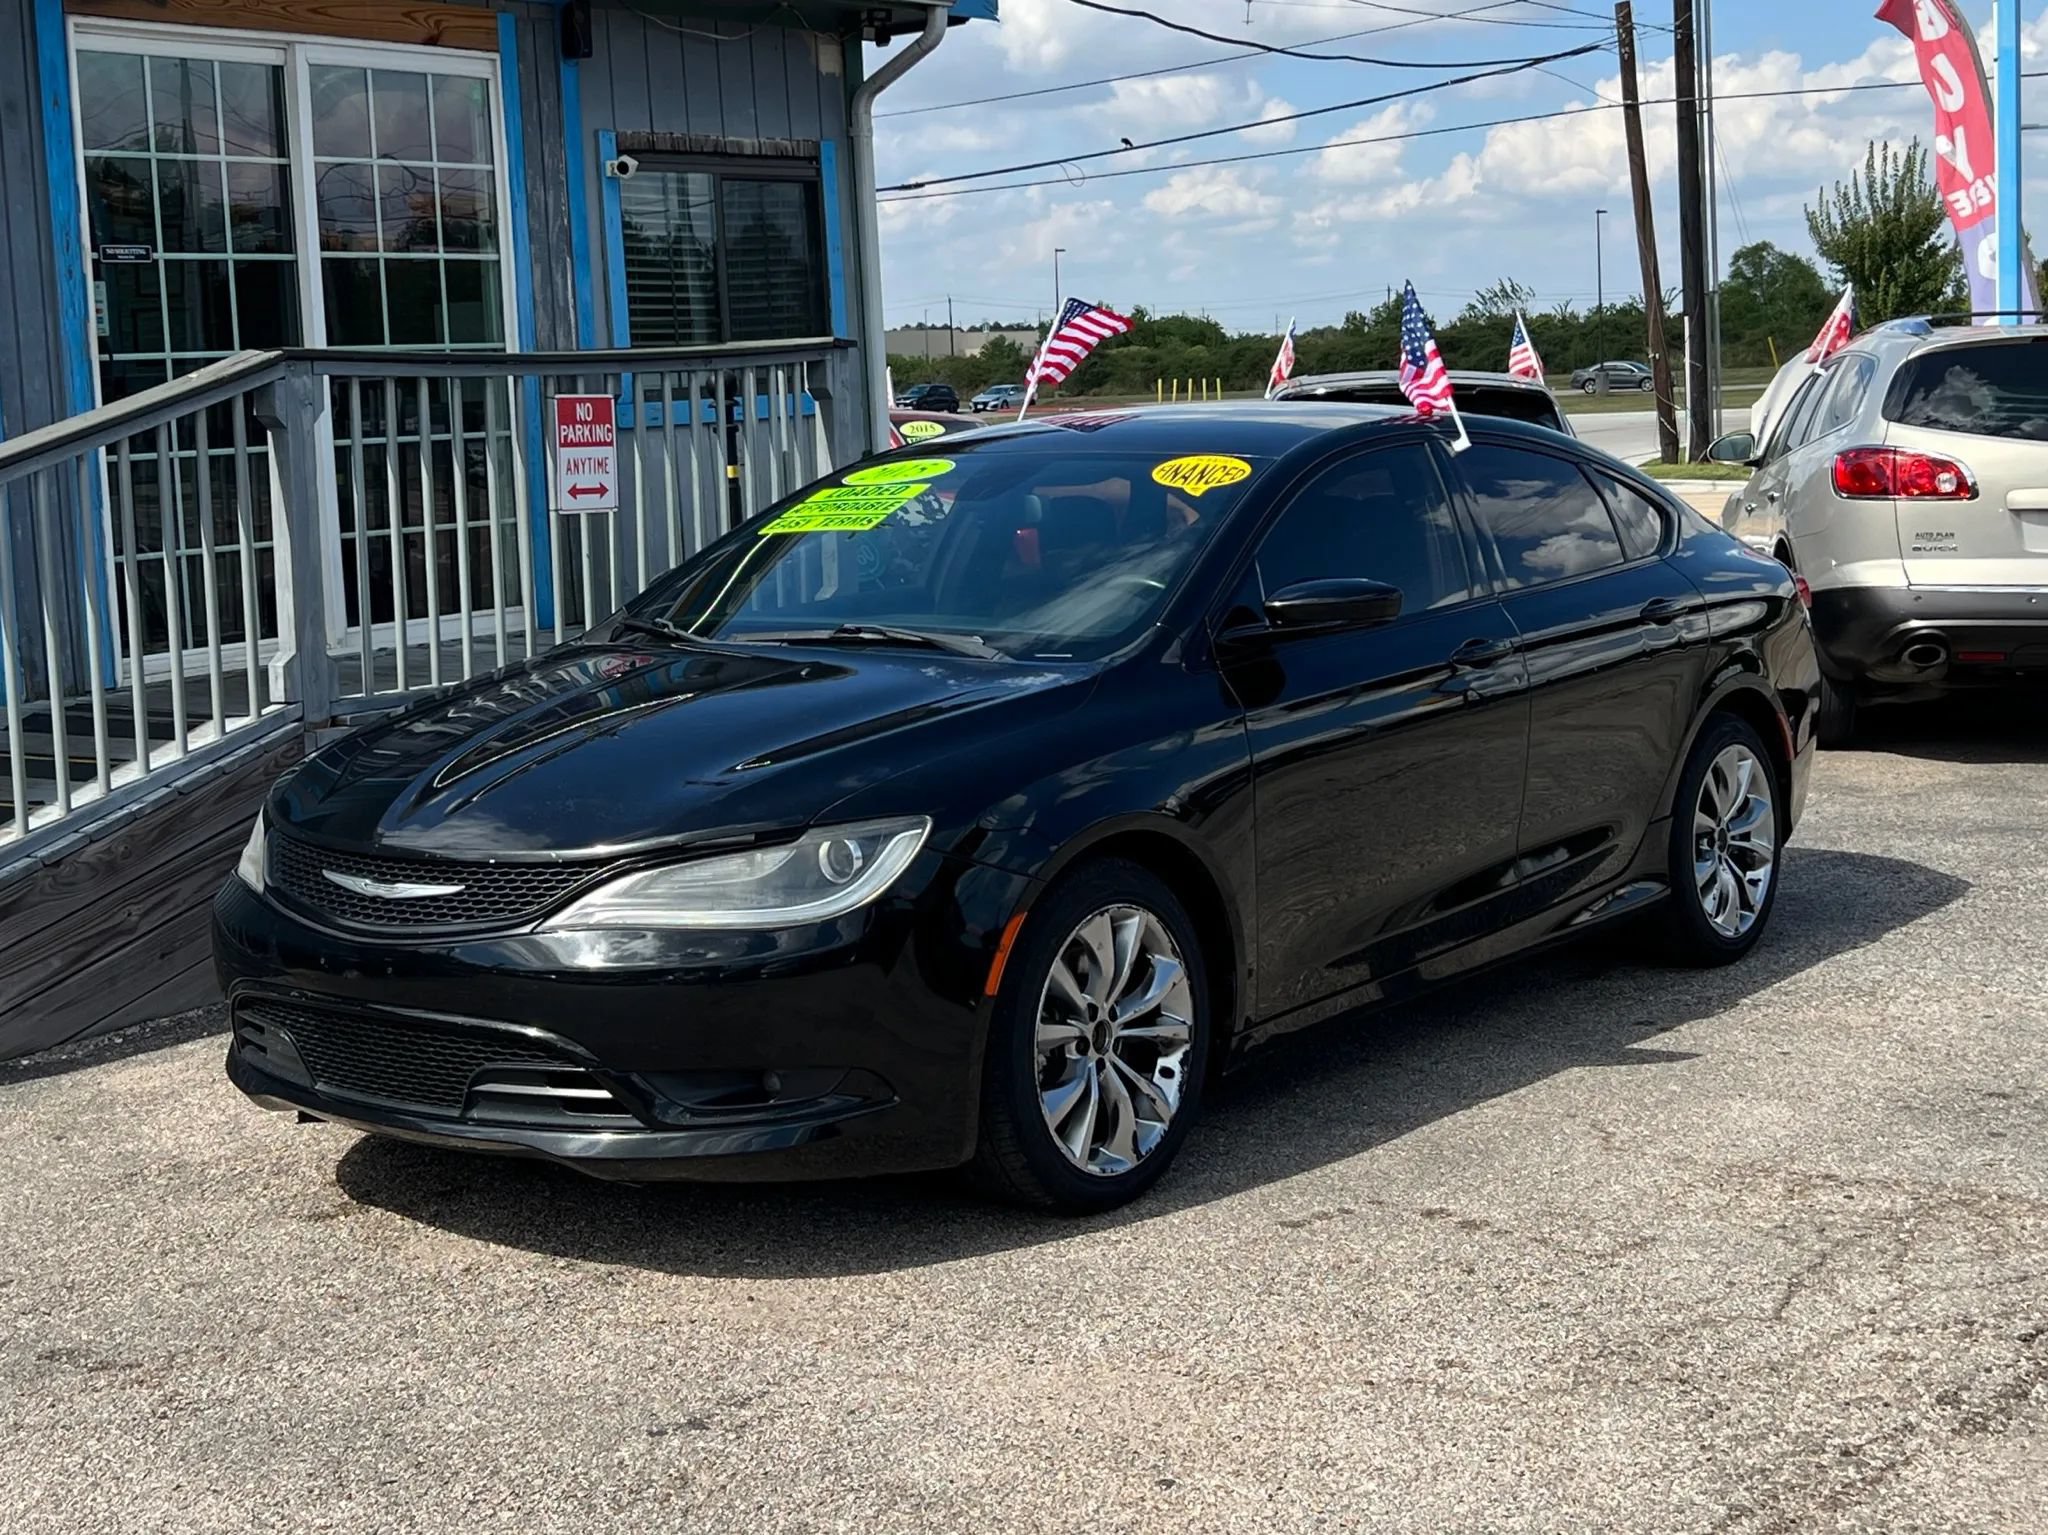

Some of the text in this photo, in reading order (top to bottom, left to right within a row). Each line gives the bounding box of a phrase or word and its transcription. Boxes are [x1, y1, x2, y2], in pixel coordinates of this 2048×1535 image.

[576, 402, 593, 421] NO
[560, 424, 612, 443] PARKING
[909, 424, 936, 434] 2015
[566, 457, 609, 475] ANYTIME
[1157, 463, 1246, 485] FINANCED
[824, 485, 911, 498] LOADED
[815, 516, 878, 528] TERMS
